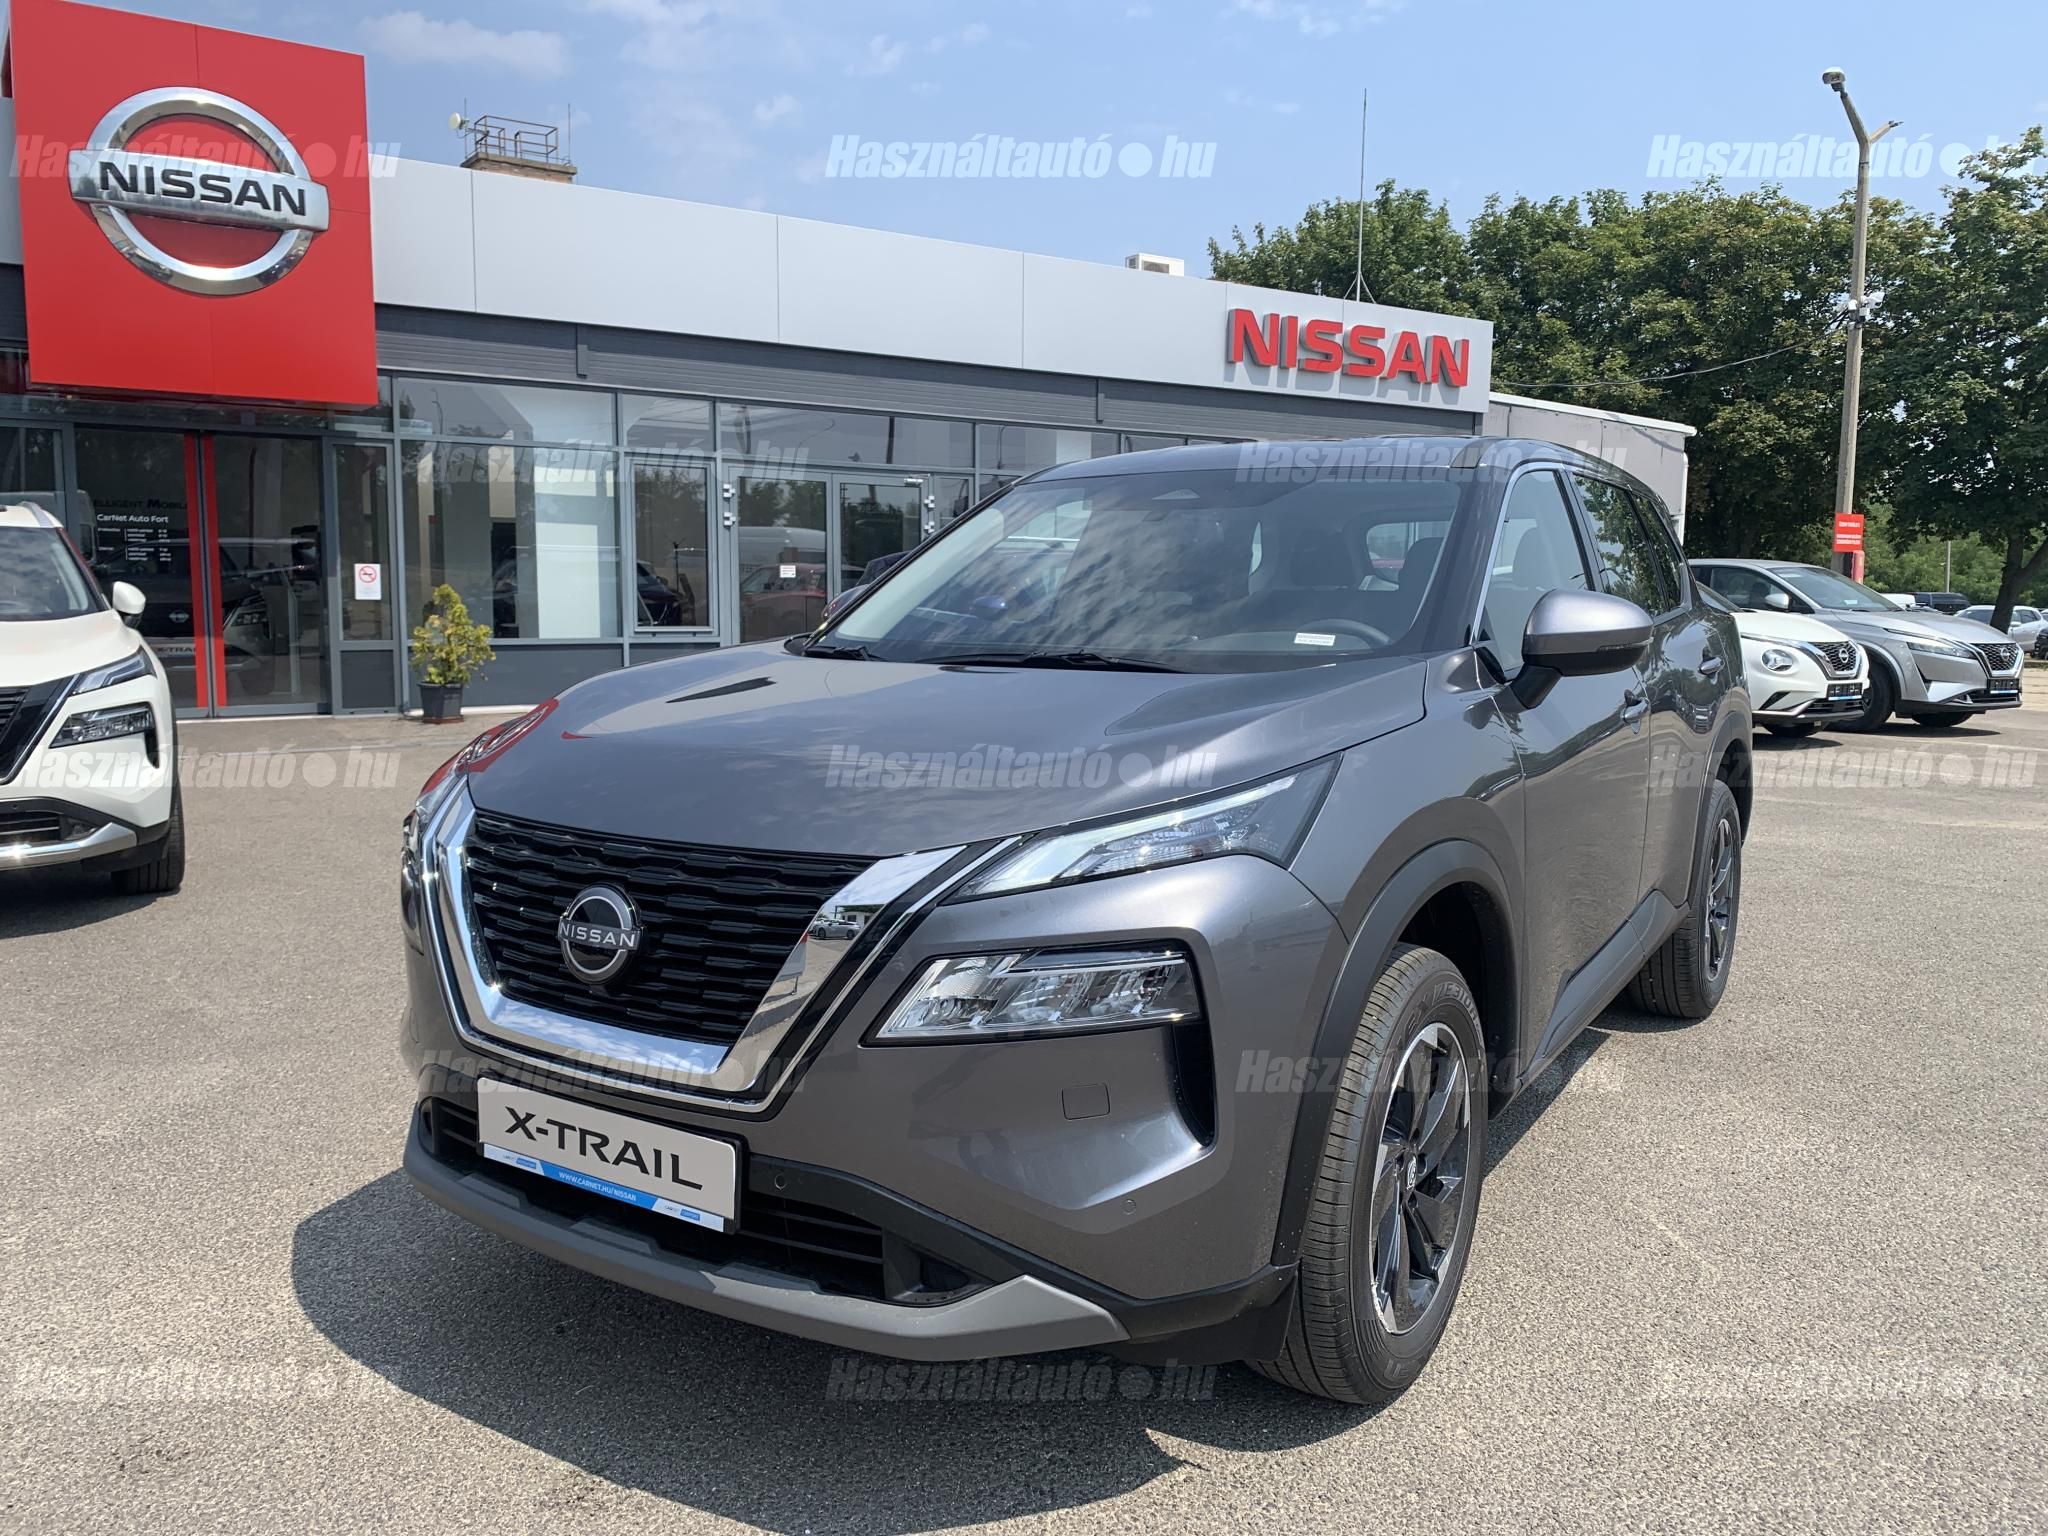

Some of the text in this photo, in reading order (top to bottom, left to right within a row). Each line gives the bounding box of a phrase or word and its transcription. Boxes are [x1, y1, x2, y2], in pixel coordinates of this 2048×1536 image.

[100, 161, 306, 216] NISSAN
[1228, 308, 1470, 387] NISSAN
[97, 513, 127, 522] CarNet
[128, 515, 150, 523] Auto
[560, 922, 635, 947] NISSAN
[505, 1106, 703, 1191] X-TRAIL
[558, 1170, 637, 1202] WWW.CARNET.HU/NISSAN
